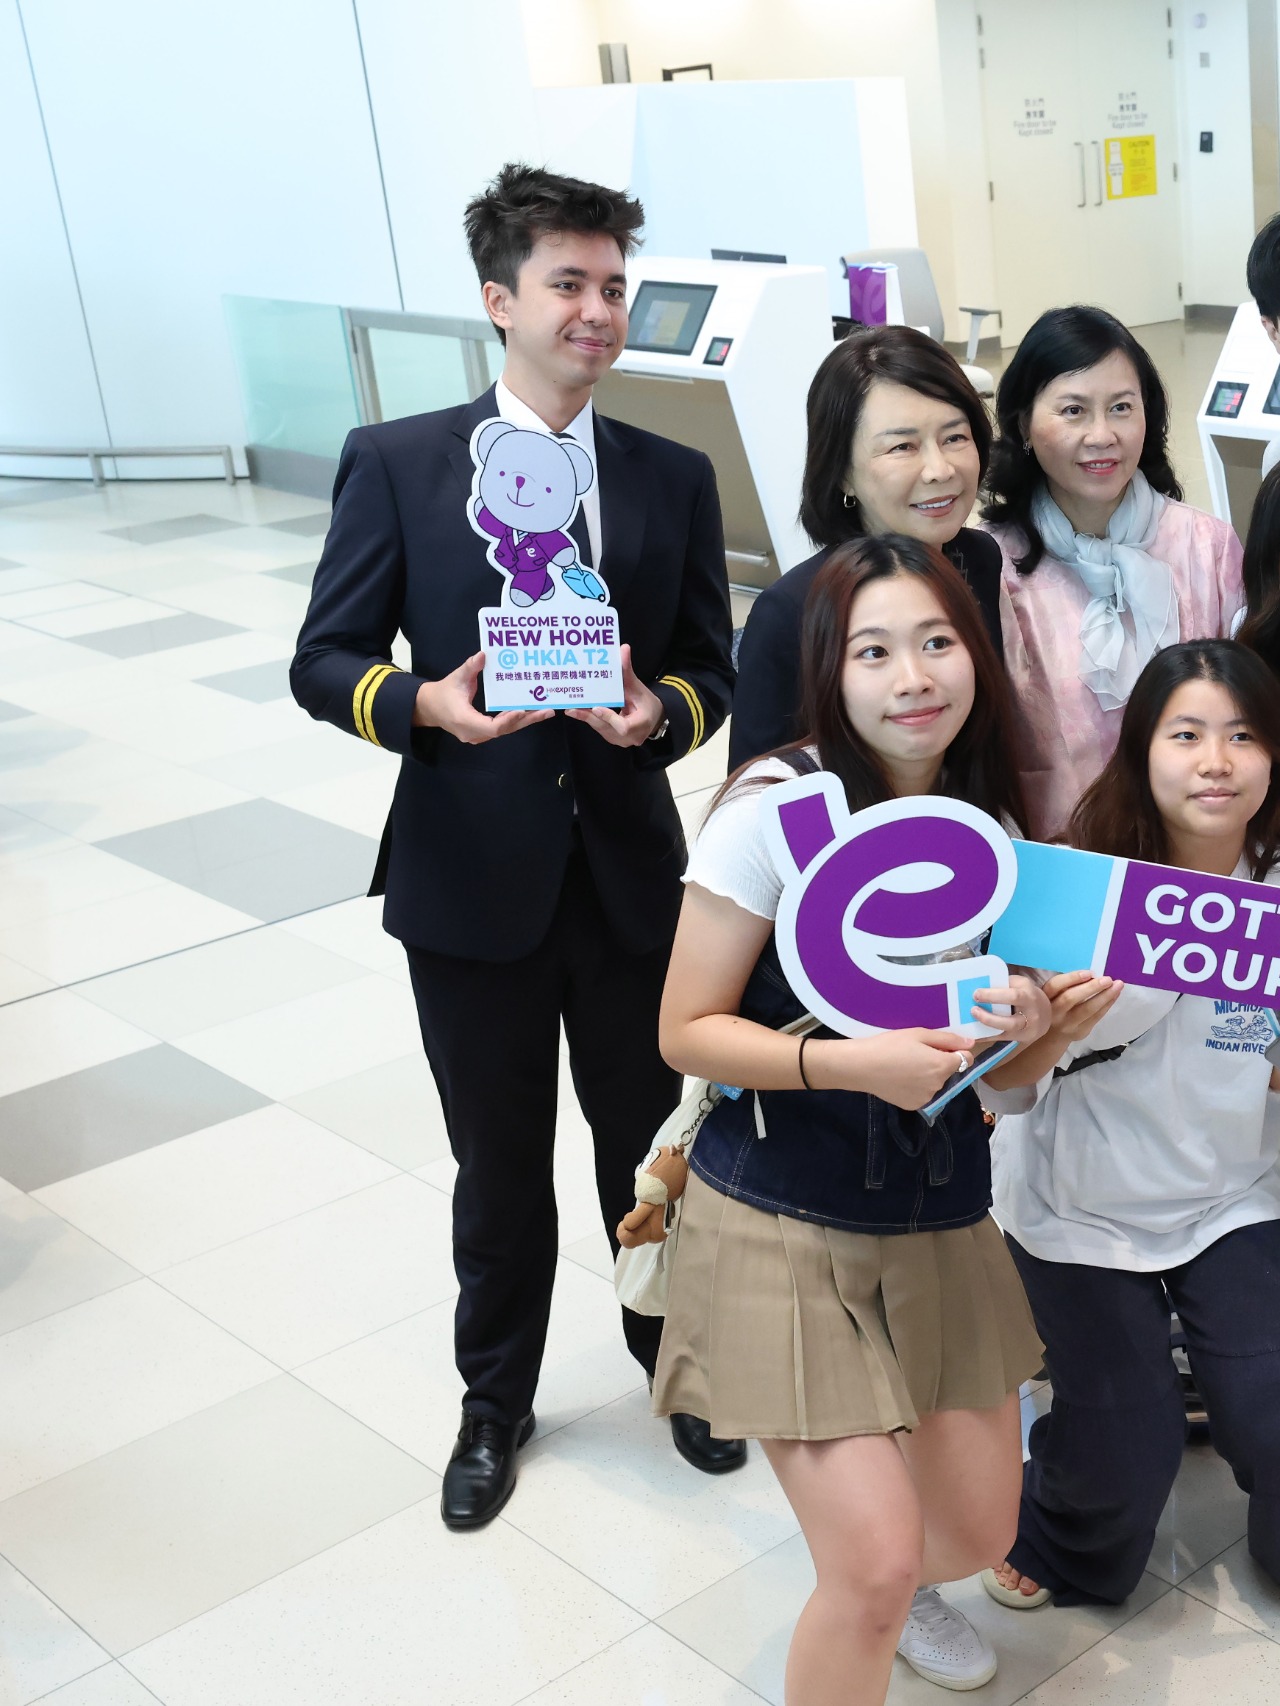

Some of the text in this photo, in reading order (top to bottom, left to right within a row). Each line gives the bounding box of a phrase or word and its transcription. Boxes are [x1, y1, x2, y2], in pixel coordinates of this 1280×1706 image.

[485, 616, 614, 628] WELCOME TO OUR
[488, 629, 615, 647] NEW HOME
[498, 648, 609, 669] @ HKIA T2
[1205, 1039, 1268, 1055] INDIAN RIVE
